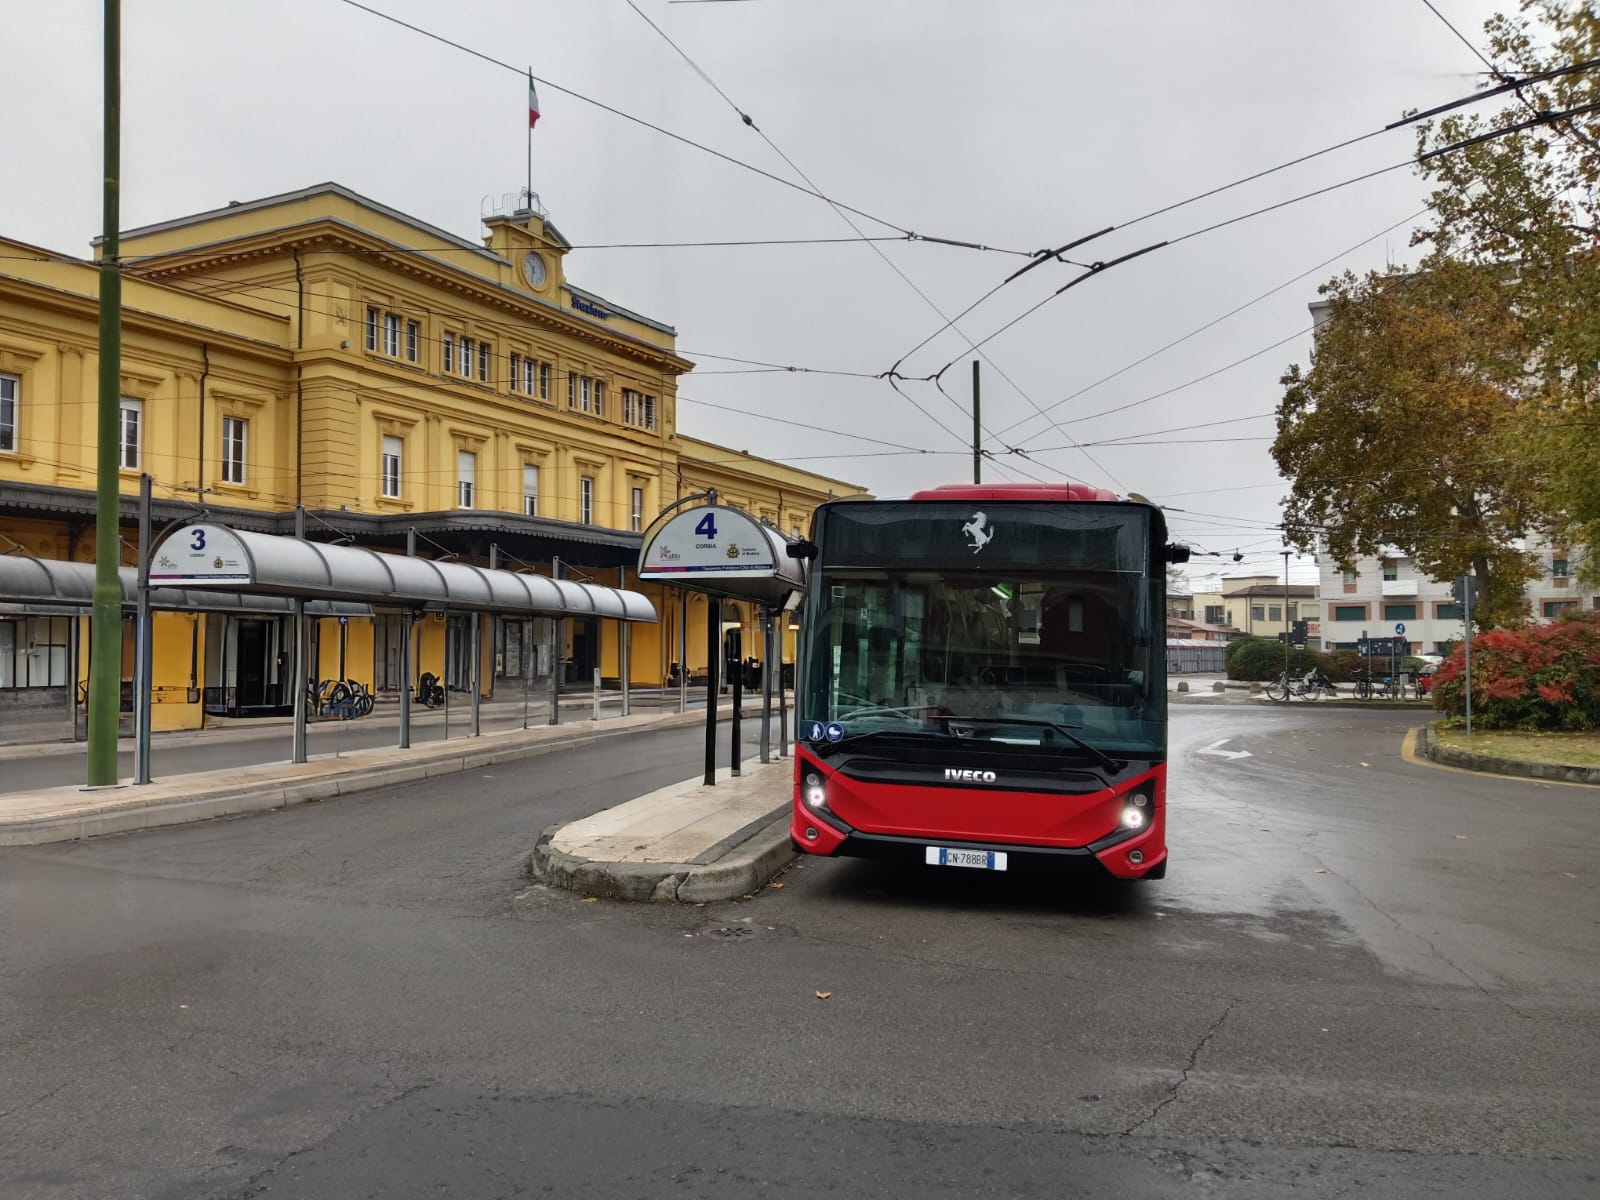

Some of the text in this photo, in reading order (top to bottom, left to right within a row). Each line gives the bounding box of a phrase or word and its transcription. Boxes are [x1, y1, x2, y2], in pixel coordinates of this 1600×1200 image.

[695, 512, 717, 539] 4
[190, 529, 206, 550] 3
[945, 769, 996, 782] IVECO
